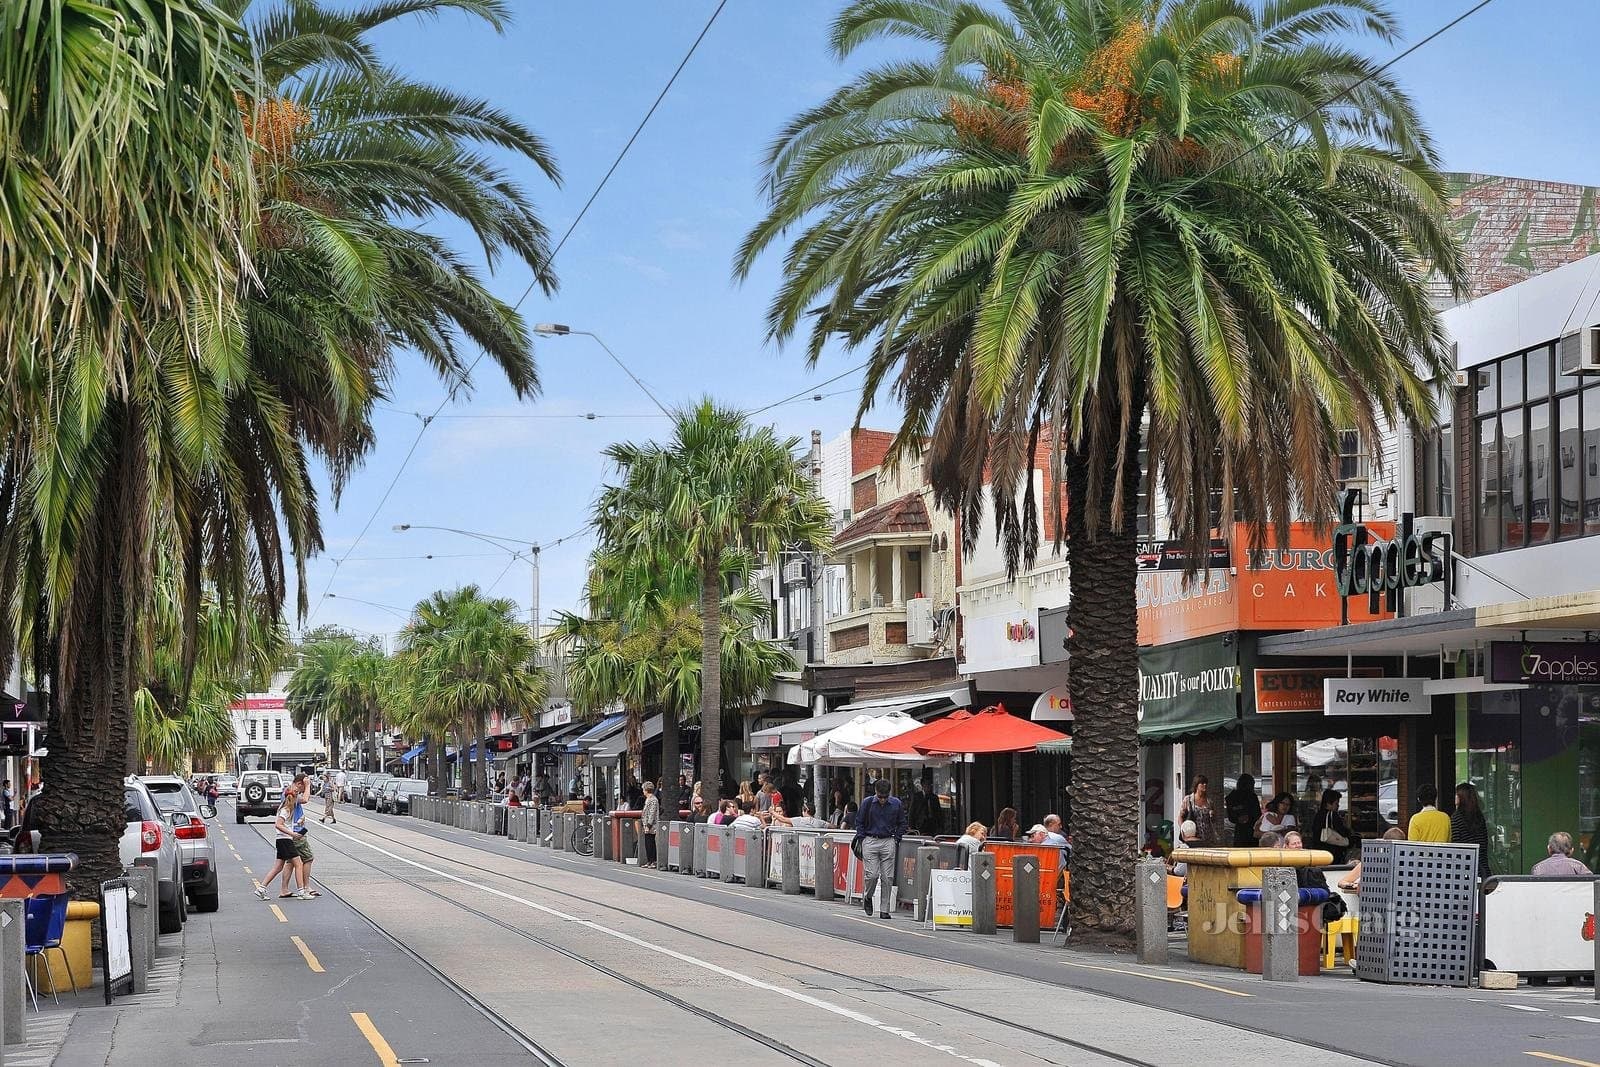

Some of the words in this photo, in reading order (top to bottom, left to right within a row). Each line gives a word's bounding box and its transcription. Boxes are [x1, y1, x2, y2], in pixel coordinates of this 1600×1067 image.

[1530, 654, 1598, 681] 7apples
[1180, 674, 1187, 692] is
[1187, 675, 1200, 691] our
[1200, 666, 1235, 693] POLICY
[1261, 673, 1321, 691] EUR
[1336, 689, 1365, 706] Ray
